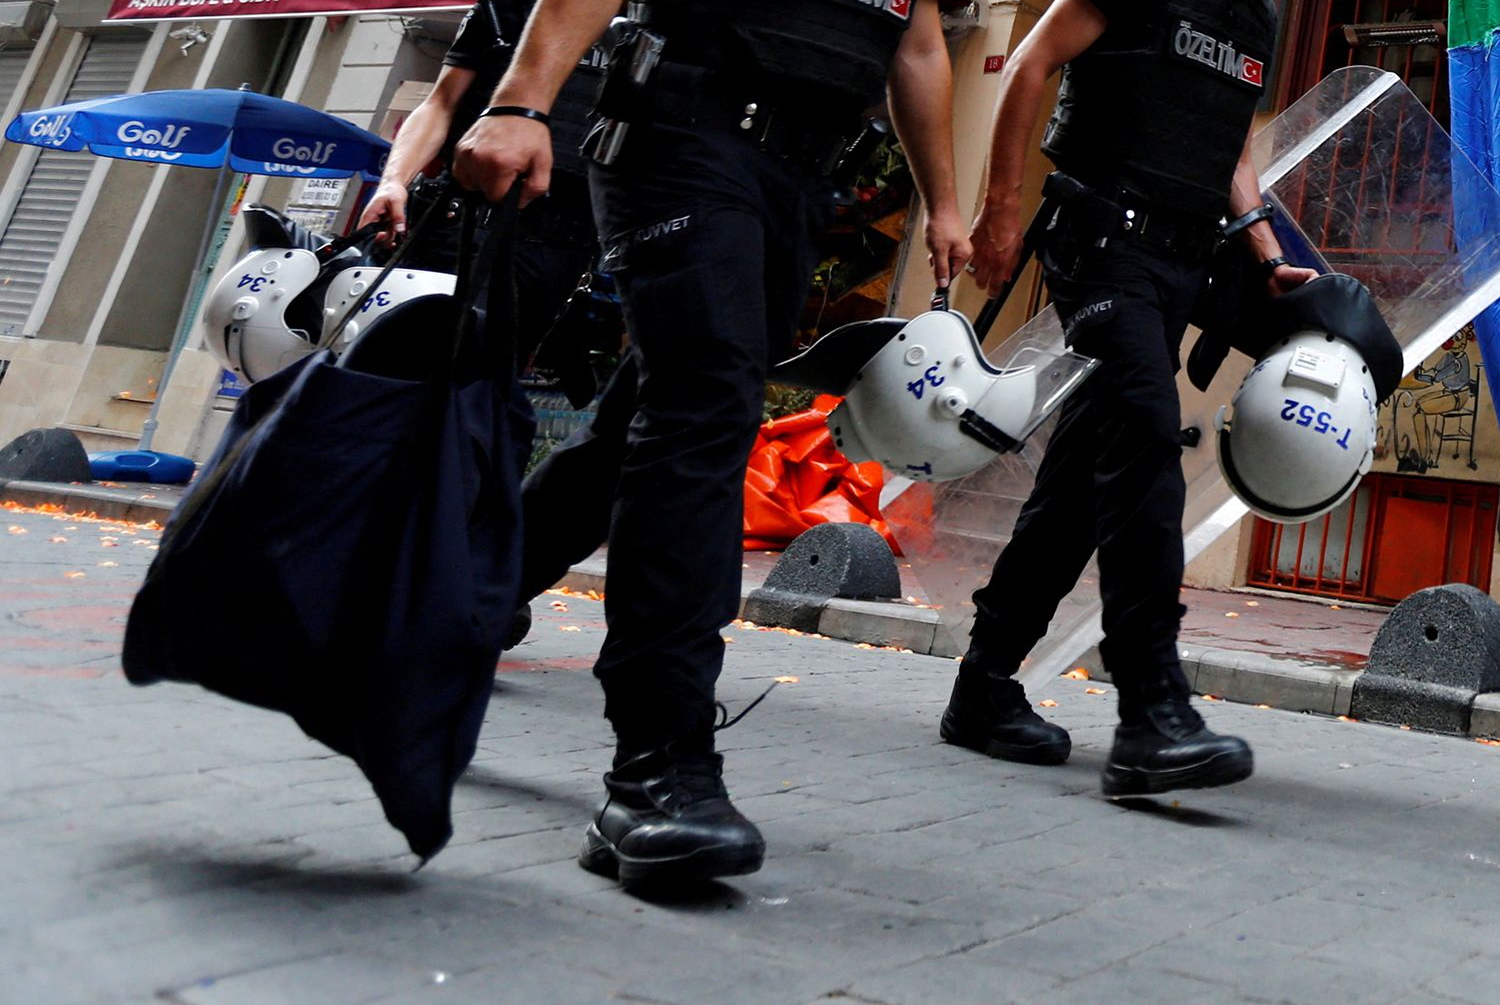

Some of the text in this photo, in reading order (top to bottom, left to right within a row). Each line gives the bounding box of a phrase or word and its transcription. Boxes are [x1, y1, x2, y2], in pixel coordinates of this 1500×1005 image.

[1174, 20, 1244, 80] ÖZEL TİM
[117, 120, 192, 149] Golf
[272, 137, 337, 165] Golf
[1280, 398, 1352, 450] T-552
